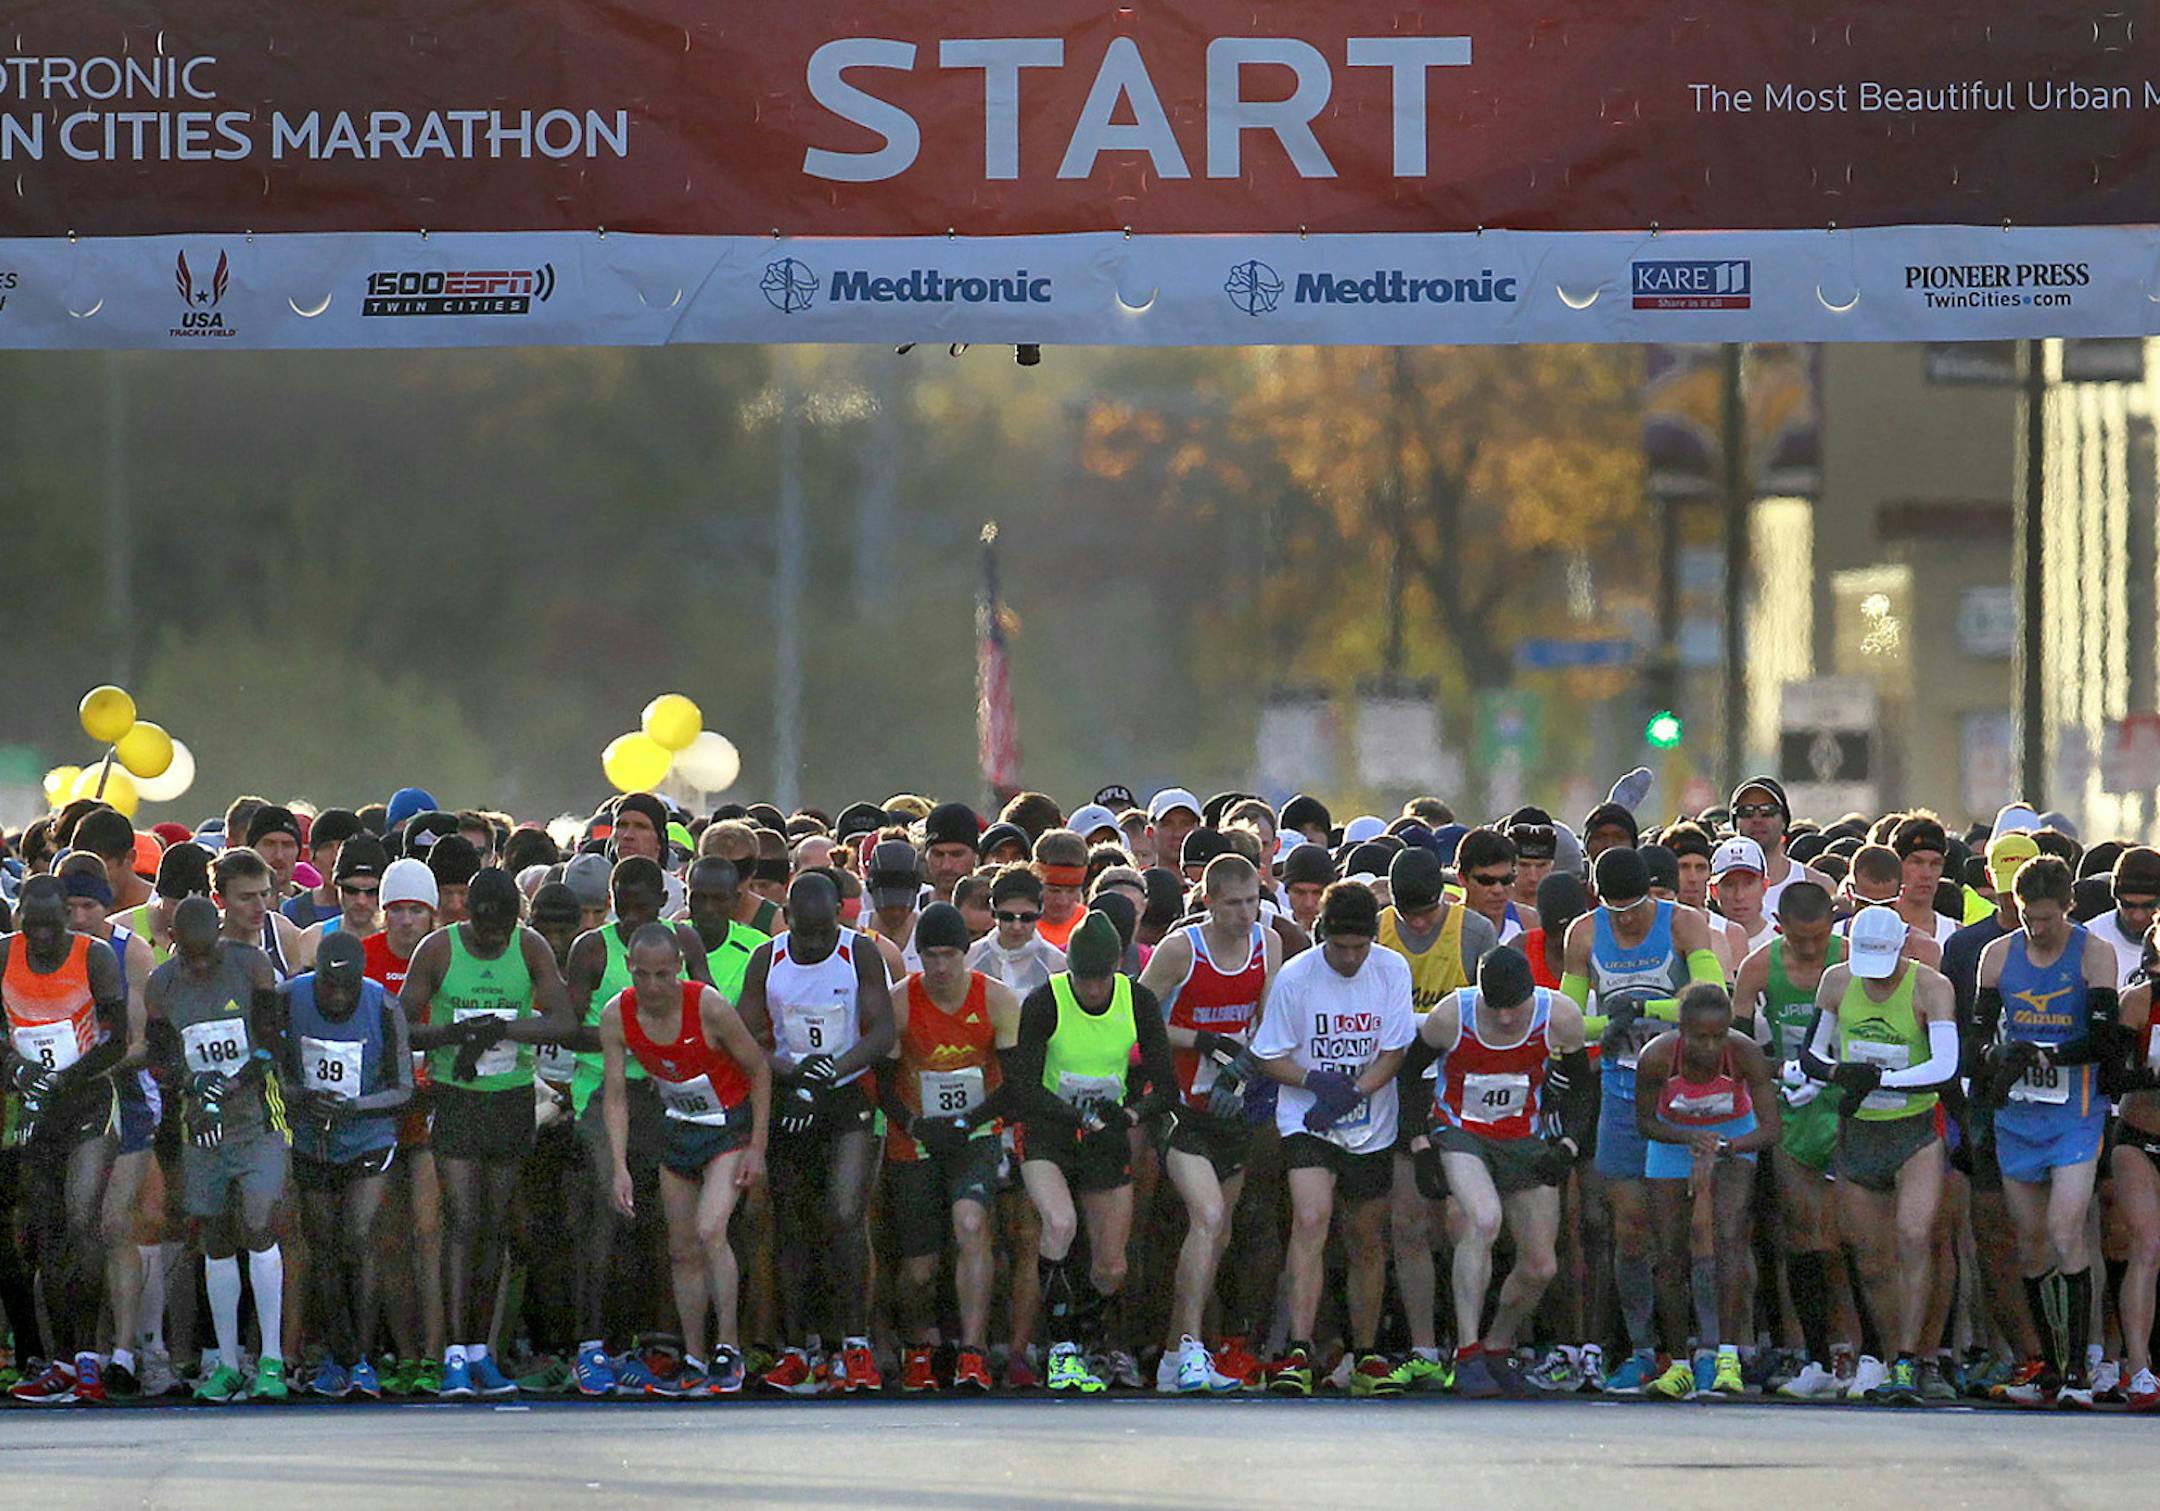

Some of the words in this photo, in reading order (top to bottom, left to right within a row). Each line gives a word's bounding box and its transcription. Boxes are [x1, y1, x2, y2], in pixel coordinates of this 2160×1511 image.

[0, 56, 217, 100] TRONIC
[802, 36, 1473, 182] START
[1688, 84, 1752, 112] The
[1765, 83, 1848, 112] Most
[1859, 81, 2016, 111] Beautiful
[2027, 81, 2131, 110] Urban
[59, 111, 252, 161] CITIES
[272, 109, 628, 160] MARATHON
[829, 269, 1052, 303] Medtronic
[1295, 269, 1517, 303] Medtronic
[1637, 266, 1711, 291] KARE
[1714, 262, 1745, 294] 11
[1905, 264, 2011, 289] PIONEER
[2016, 263, 2090, 287] PRESS
[371, 302, 427, 313] TWIN
[443, 300, 522, 312] CITIES
[182, 313, 223, 328] USA
[810, 1027, 822, 1048] 9
[40, 1048, 55, 1068] 8
[196, 1039, 238, 1063] 188
[317, 1058, 342, 1082] 39
[940, 1090, 967, 1110] 33
[1482, 1089, 1510, 1107] 40
